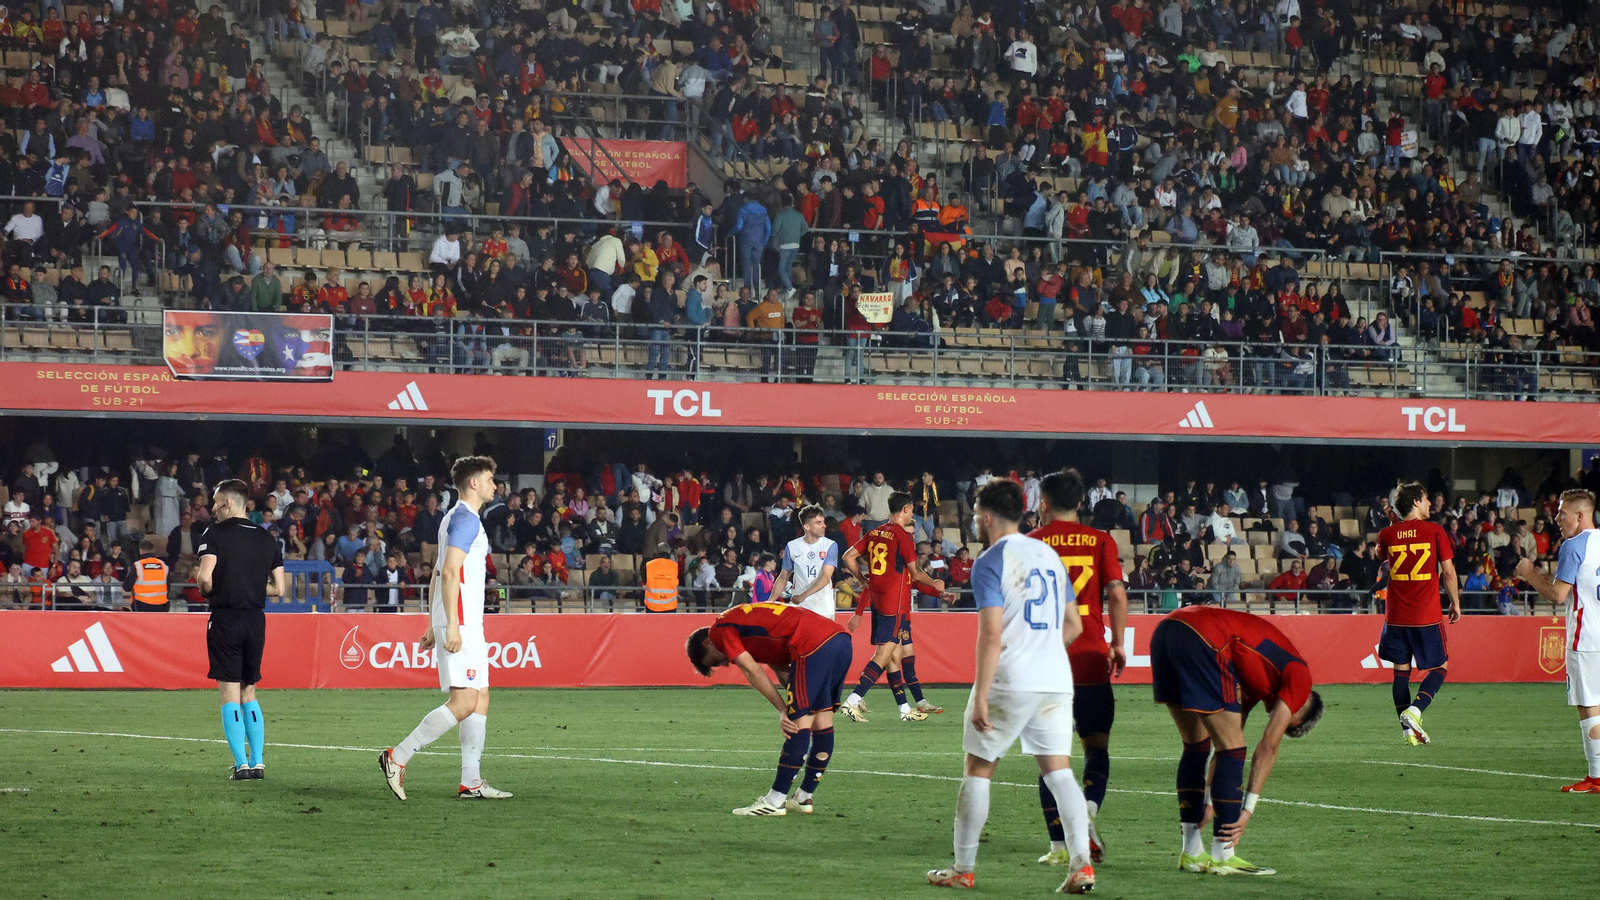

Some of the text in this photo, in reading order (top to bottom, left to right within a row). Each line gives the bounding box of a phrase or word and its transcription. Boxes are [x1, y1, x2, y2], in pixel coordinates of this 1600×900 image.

[624, 151, 680, 160] ESPAÑOLA
[860, 294, 892, 303] NAVARRO
[37, 369, 199, 383] SELECCIÓN ESPAÑ
[80, 383, 160, 394] DE FÚTBOL
[92, 396, 144, 406] SUB-21
[646, 389, 722, 417] TCL
[877, 391, 1017, 403] SELECCIÓN ESPAÑOLA
[914, 403, 983, 414] DE FÚTBOL
[925, 416, 969, 425] SUB-21
[1401, 406, 1466, 432] TCL
[547, 435, 556, 448] 17
[1042, 534, 1097, 547] MOLEIRO
[1397, 529, 1417, 539] UNAI
[867, 540, 888, 576] 18
[1388, 542, 1431, 581] 22
[806, 565, 817, 578] 14
[1023, 568, 1059, 630] 21
[369, 636, 542, 669] CABROÁ
